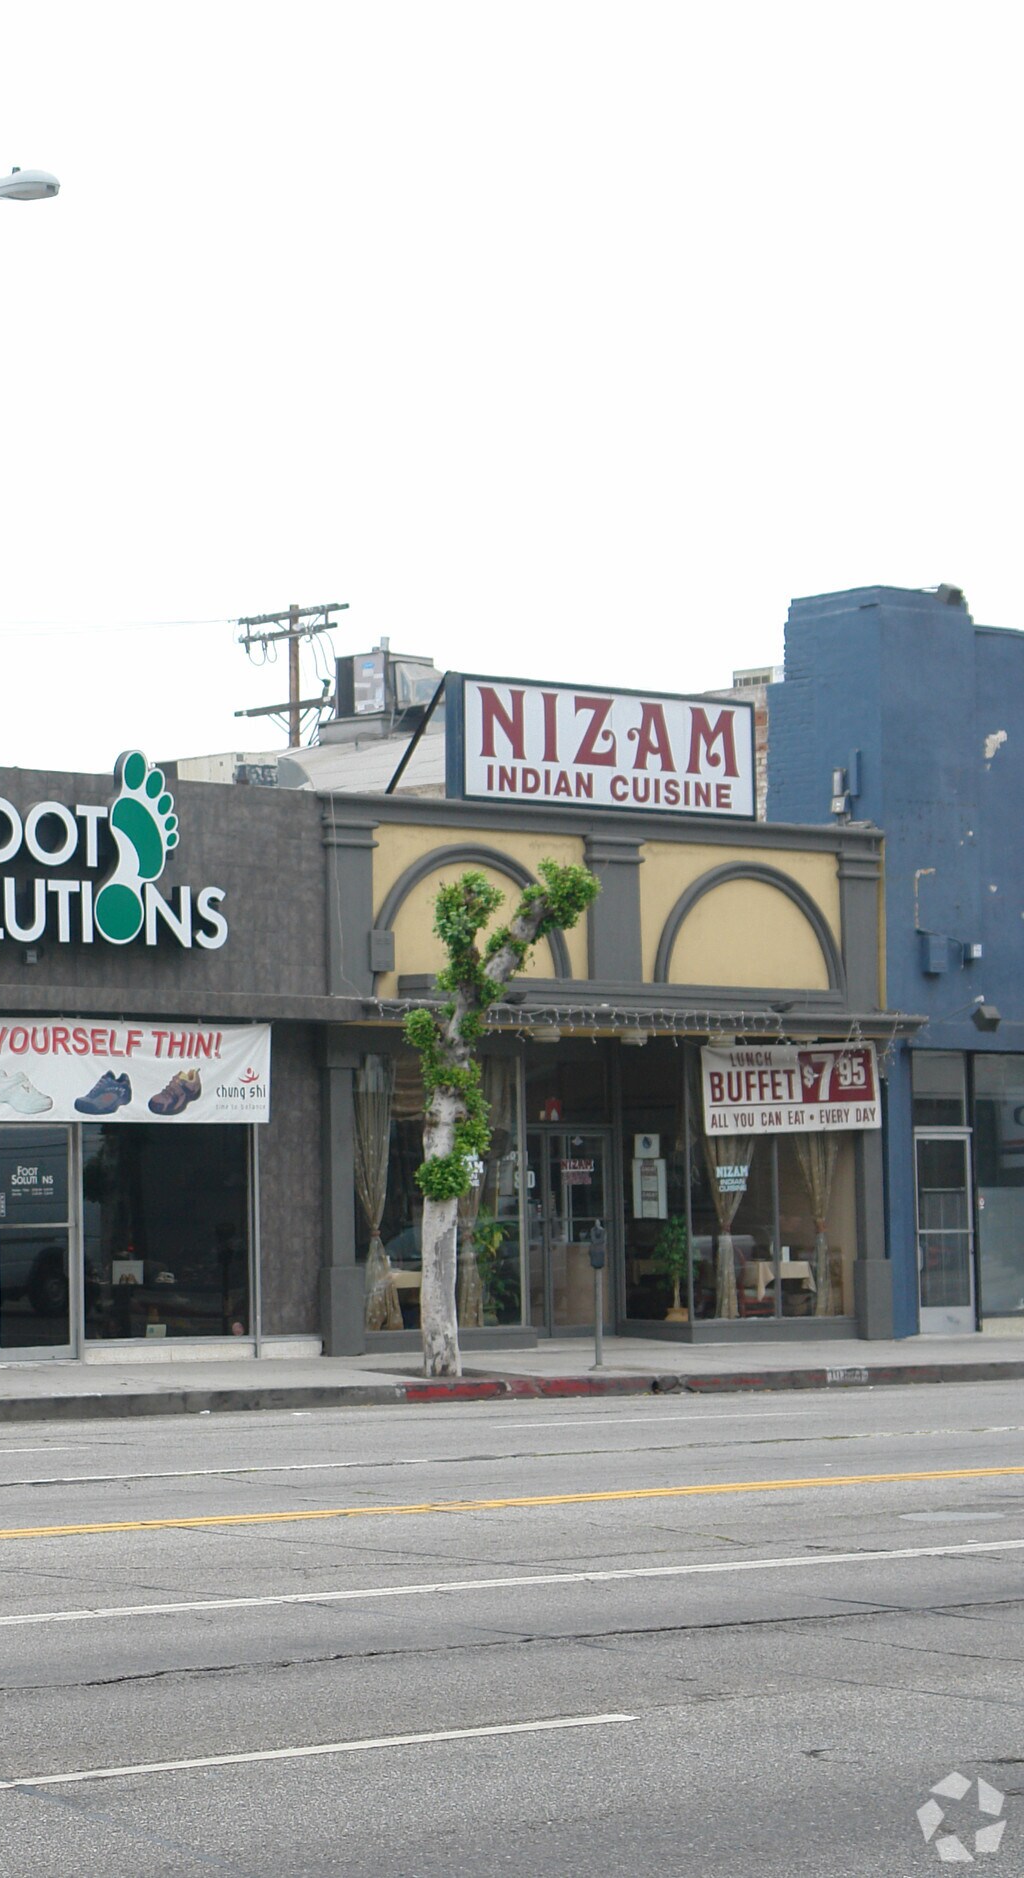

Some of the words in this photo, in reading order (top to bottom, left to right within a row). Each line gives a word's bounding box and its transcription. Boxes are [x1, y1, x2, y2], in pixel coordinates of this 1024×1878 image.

[477, 686, 740, 777] NIZAM
[487, 764, 594, 798] INDIAN
[610, 774, 732, 808] CUISINE
[152, 1031, 222, 1059] THIN!
[730, 1052, 772, 1067] LUNCH
[216, 1084, 246, 1100] chung
[250, 1084, 266, 1098] shi
[710, 1069, 795, 1103] BUFFET
[711, 1113, 729, 1128] ALL
[733, 1113, 754, 1127] YOU
[761, 1111, 782, 1126] CAN
[788, 1110, 805, 1125] EAT
[820, 1109, 850, 1123] EVERY
[856, 1108, 876, 1122] DAY
[17, 1165, 38, 1176] FOOT
[716, 1166, 749, 1178] NIZAM
